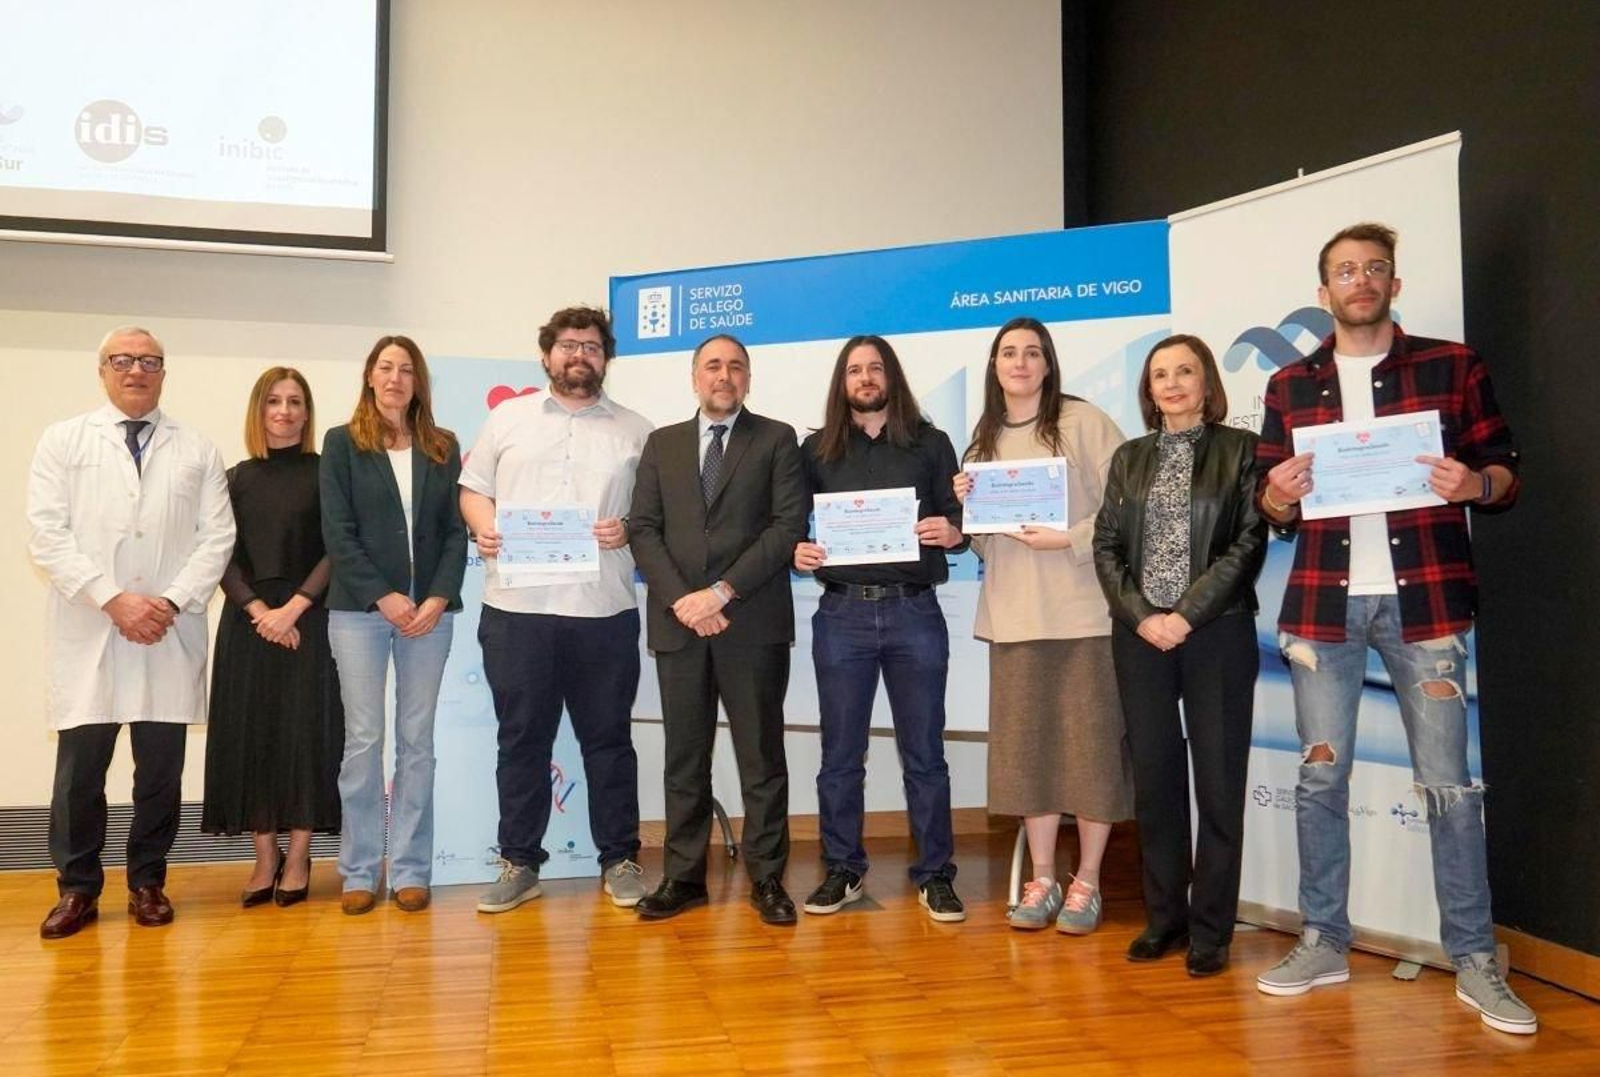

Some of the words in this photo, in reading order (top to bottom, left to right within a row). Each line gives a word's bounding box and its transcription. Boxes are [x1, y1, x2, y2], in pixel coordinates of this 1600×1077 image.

[79, 111, 169, 147] idis
[219, 135, 286, 161] inibic
[689, 284, 742, 300] SERVIZO
[950, 291, 990, 309] ÁREA
[993, 285, 1072, 305] SANITARIA
[1077, 283, 1098, 298] DE
[1102, 279, 1142, 295] VIGO
[689, 299, 744, 315] GALEGO
[689, 317, 707, 330] DE
[709, 312, 754, 329] SAÚDE
